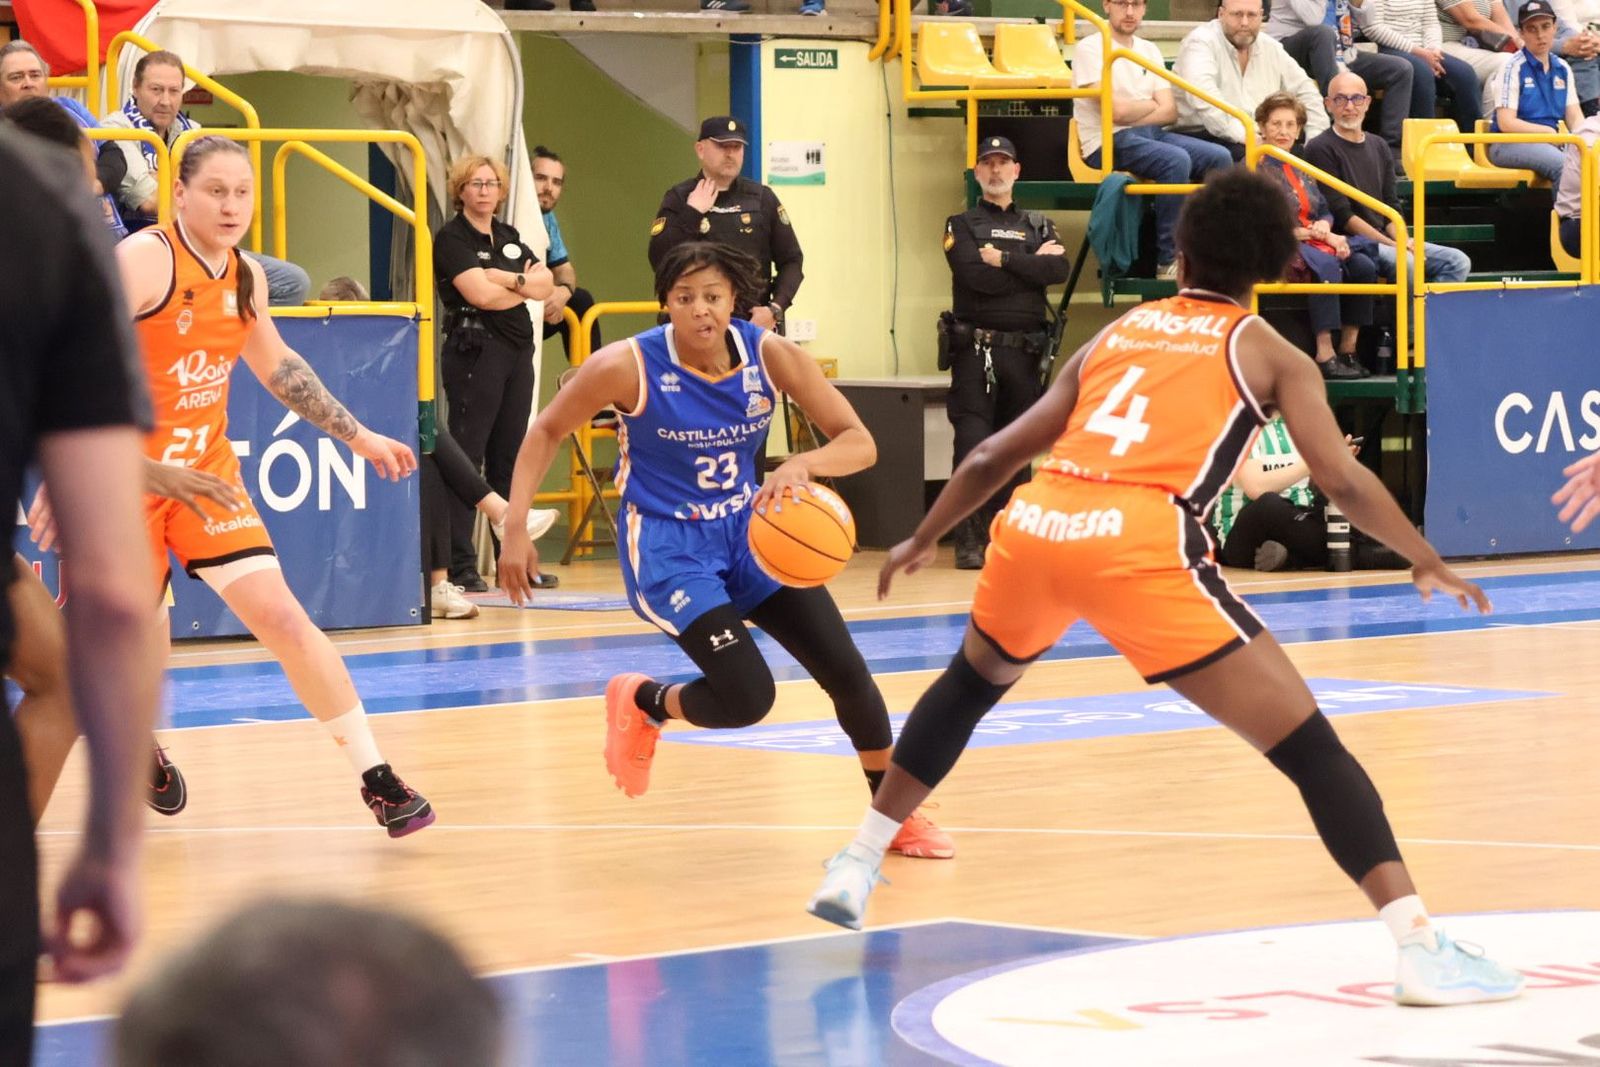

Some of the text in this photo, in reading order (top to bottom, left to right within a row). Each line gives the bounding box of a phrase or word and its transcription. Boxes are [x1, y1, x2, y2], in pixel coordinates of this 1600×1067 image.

[796, 51, 834, 67] SALIDA
[1121, 308, 1228, 339] FINGALL
[1083, 364, 1151, 457] 4
[161, 424, 211, 468] 21
[657, 427, 728, 442] CASTILLA
[729, 424, 739, 438] Y
[231, 408, 366, 512] ÓN
[694, 450, 739, 491] 23
[1007, 498, 1124, 542] PAMESA
